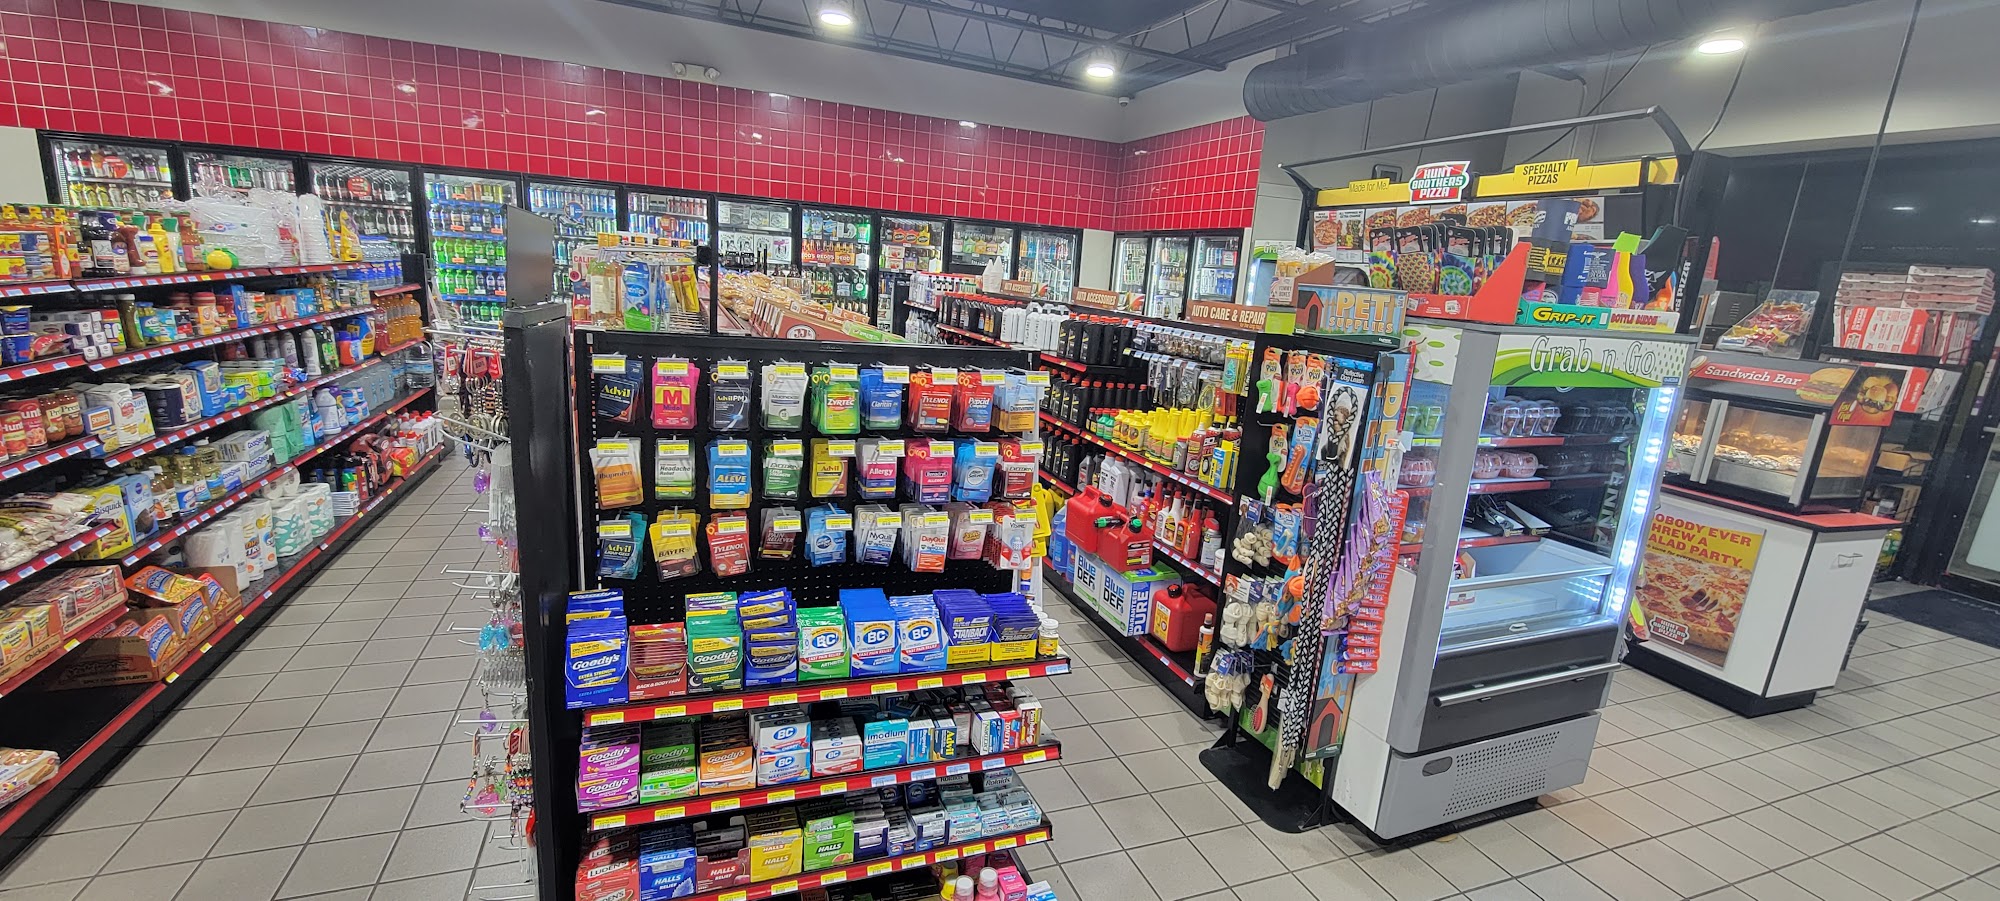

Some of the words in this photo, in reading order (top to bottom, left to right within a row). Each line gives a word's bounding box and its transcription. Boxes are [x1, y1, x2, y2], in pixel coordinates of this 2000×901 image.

[1423, 167, 1453, 179] HUNT
[1523, 162, 1569, 176] SPECIALTY
[1412, 176, 1464, 190] BROTHERS
[1528, 174, 1558, 185] PIZZAS
[1349, 183, 1366, 192] Made
[1367, 182, 1376, 192] for
[1419, 187, 1450, 198] PIZZA
[1677, 260, 1692, 297] PIZZA
[1076, 291, 1086, 300] AUTO
[1086, 292, 1117, 306] ACCESSORIES
[1336, 291, 1391, 322] PET
[1192, 304, 1208, 318] AUTO
[1210, 306, 1230, 322] CARE
[1232, 309, 1238, 322] &
[1239, 310, 1266, 325] REPAIR
[1532, 306, 1596, 324] GRIP-IT
[1610, 313, 1634, 324] BOTTLE
[1329, 316, 1393, 334] SUPPLIES
[1530, 335, 1592, 373] Grab
[1600, 348, 1616, 374] n
[1624, 340, 1656, 376] Go
[1291, 367, 1304, 376] Play
[1309, 372, 1320, 380] Play
[1704, 366, 1771, 382] Sandwich
[1773, 374, 1802, 386] Bar
[602, 384, 631, 398] Advil
[662, 389, 680, 404] M
[828, 398, 855, 406] ZYRTEC
[871, 400, 892, 410] Claritin
[922, 396, 950, 406] TYLENOL
[968, 397, 990, 406] Pepcid
[600, 470, 634, 480] Ibuprofen
[660, 466, 692, 474] Headache
[868, 466, 894, 478] Allergy
[716, 474, 747, 484] ALEVE
[95, 501, 122, 514] Bisquick
[1651, 522, 1696, 542] HREW
[1698, 536, 1708, 547] A
[1655, 513, 1706, 534] OBODY
[1708, 526, 1752, 547] EVER
[870, 532, 894, 542] NyQuil
[922, 535, 946, 544] DayQuil
[606, 544, 632, 553] Advil
[658, 548, 686, 558] BAYER
[713, 544, 744, 555] TYLENOL
[1648, 534, 1686, 551] ALAD
[1689, 544, 1744, 569] PARTY.
[1077, 566, 1096, 588] DEF
[1103, 587, 1124, 612] DEF
[1128, 590, 1137, 636] GUARANTEED
[1133, 590, 1149, 636] PURE
[868, 630, 888, 644] BC
[912, 628, 929, 640] BC
[953, 627, 988, 638] STANBACK
[816, 632, 838, 648] BC
[24, 644, 50, 662] Chicken
[694, 650, 738, 664] Goody's
[572, 654, 620, 672] Goody's
[821, 660, 845, 668] ARTHRITIS
[778, 729, 794, 740] BC
[867, 730, 906, 740] Imodium
[1003, 721, 1011, 749] TYLENOL
[945, 730, 954, 755] Advil
[588, 747, 630, 762] Goody's
[647, 747, 689, 761] Goody's
[708, 750, 745, 764] Goody's
[779, 758, 792, 767] BC
[586, 778, 629, 793] Goody's
[986, 778, 1010, 786] Rolaids
[591, 842, 628, 858] LUDEN'S
[818, 844, 842, 852] HALLS
[765, 856, 789, 864] HALLS
[590, 861, 627, 876] LUDEN'S
[711, 866, 736, 876] HALLS
[656, 875, 681, 885] HALLS
